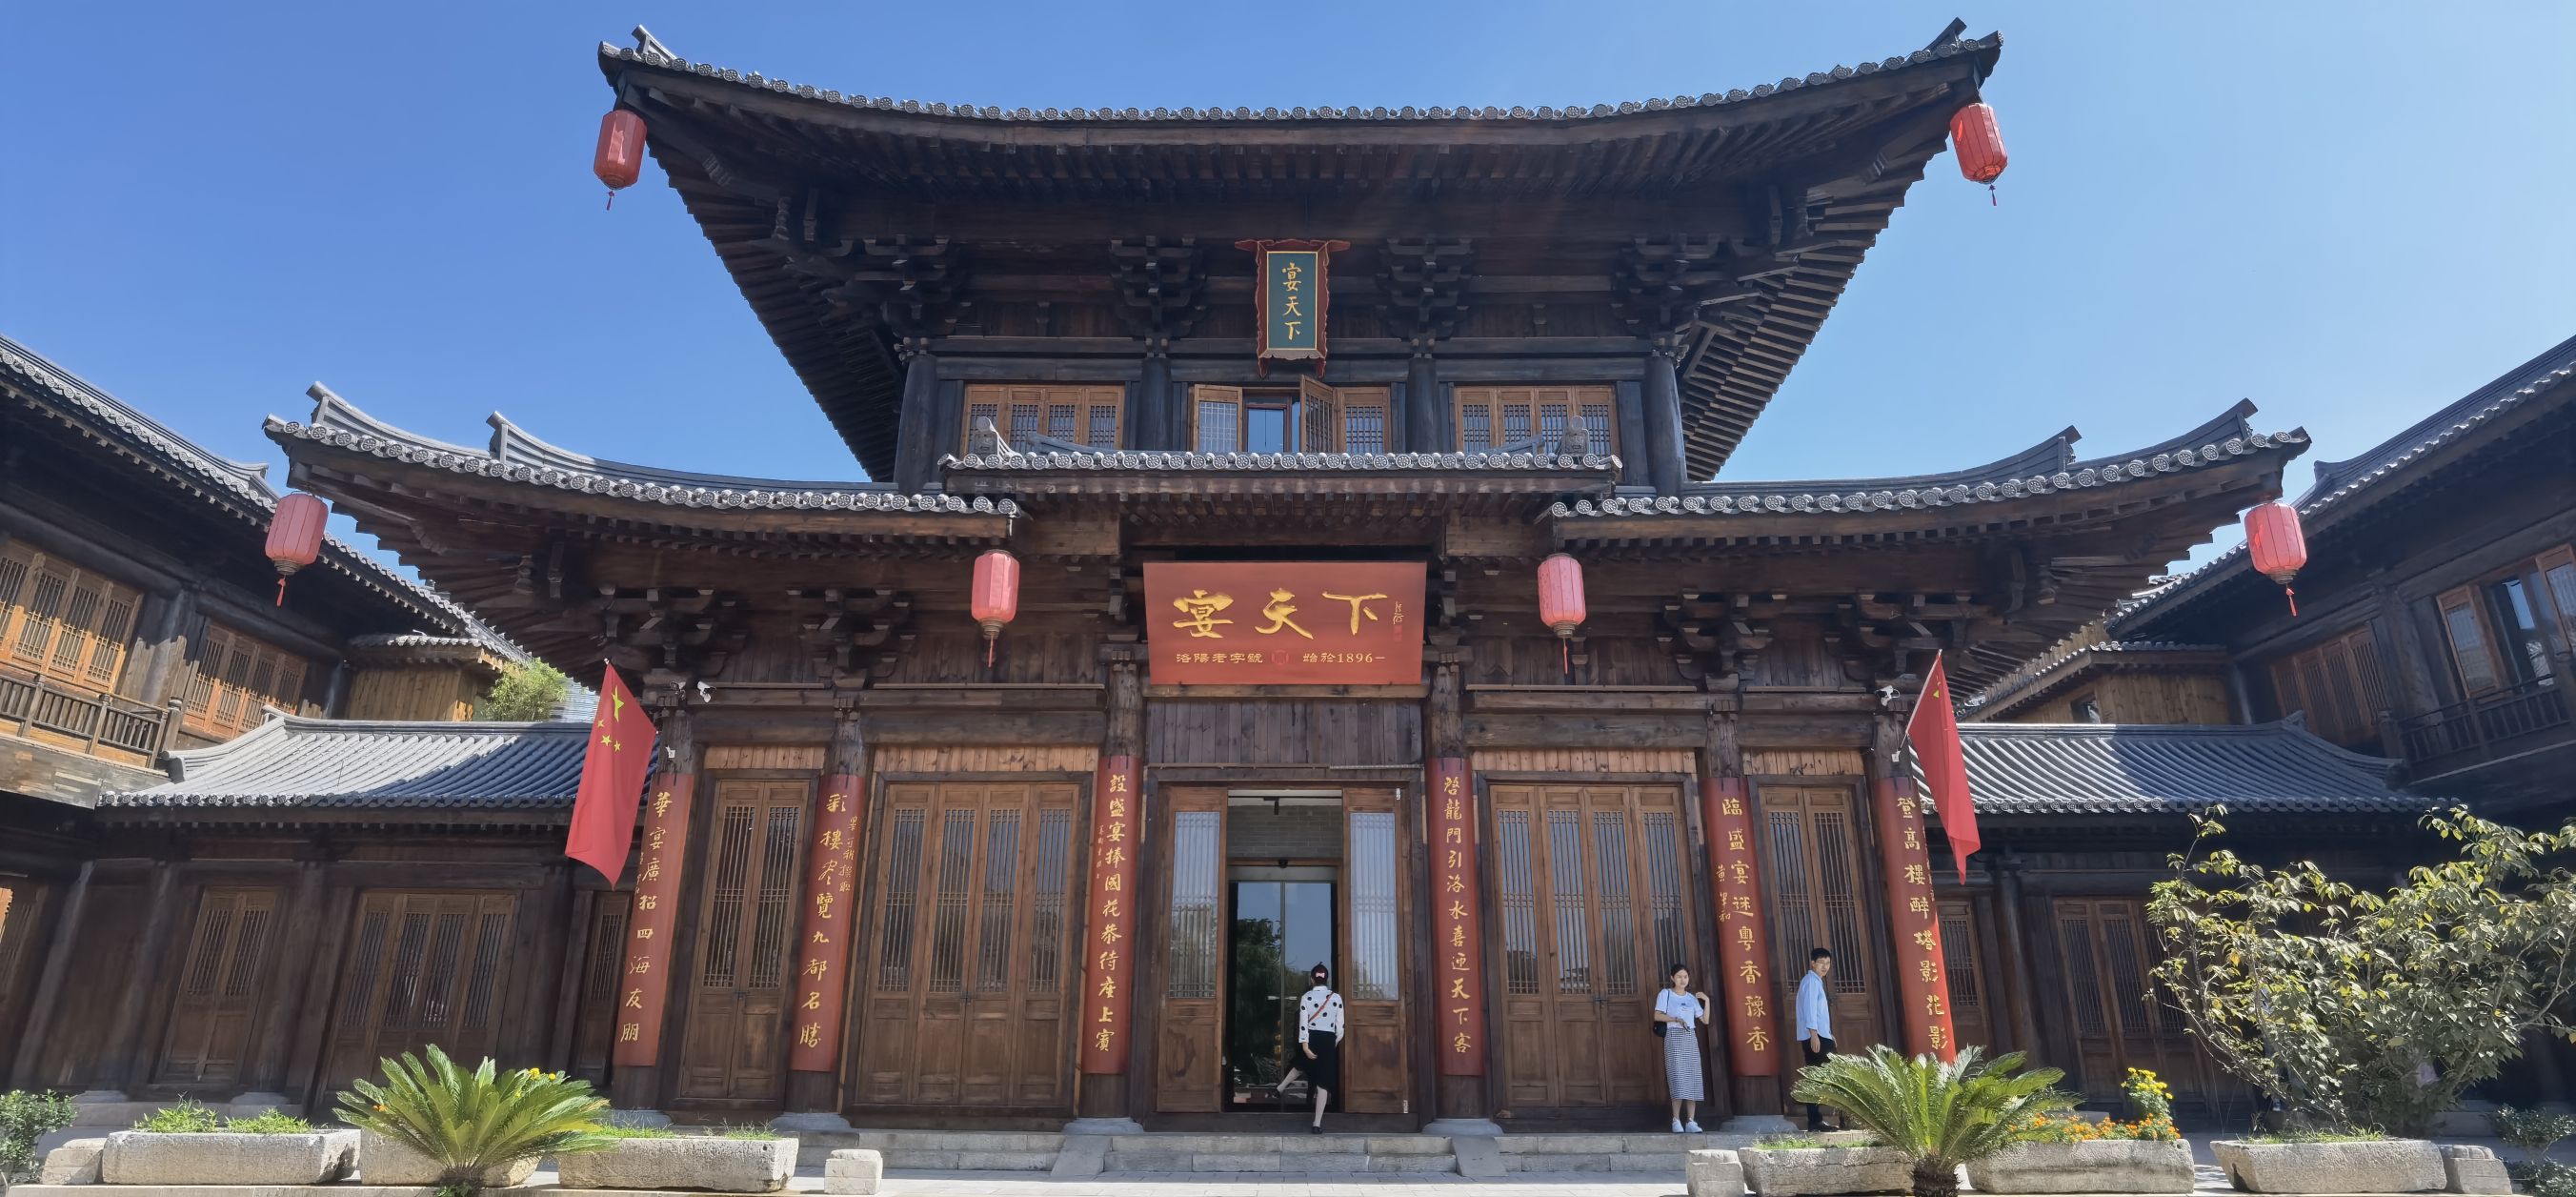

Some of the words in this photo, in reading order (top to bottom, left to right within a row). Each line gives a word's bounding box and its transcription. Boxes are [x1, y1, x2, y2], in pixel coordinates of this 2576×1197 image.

[1281, 262, 1302, 340] 宴天下
[1173, 588, 1388, 639] 宴天下
[1176, 652, 1263, 664] 洛陽老字號
